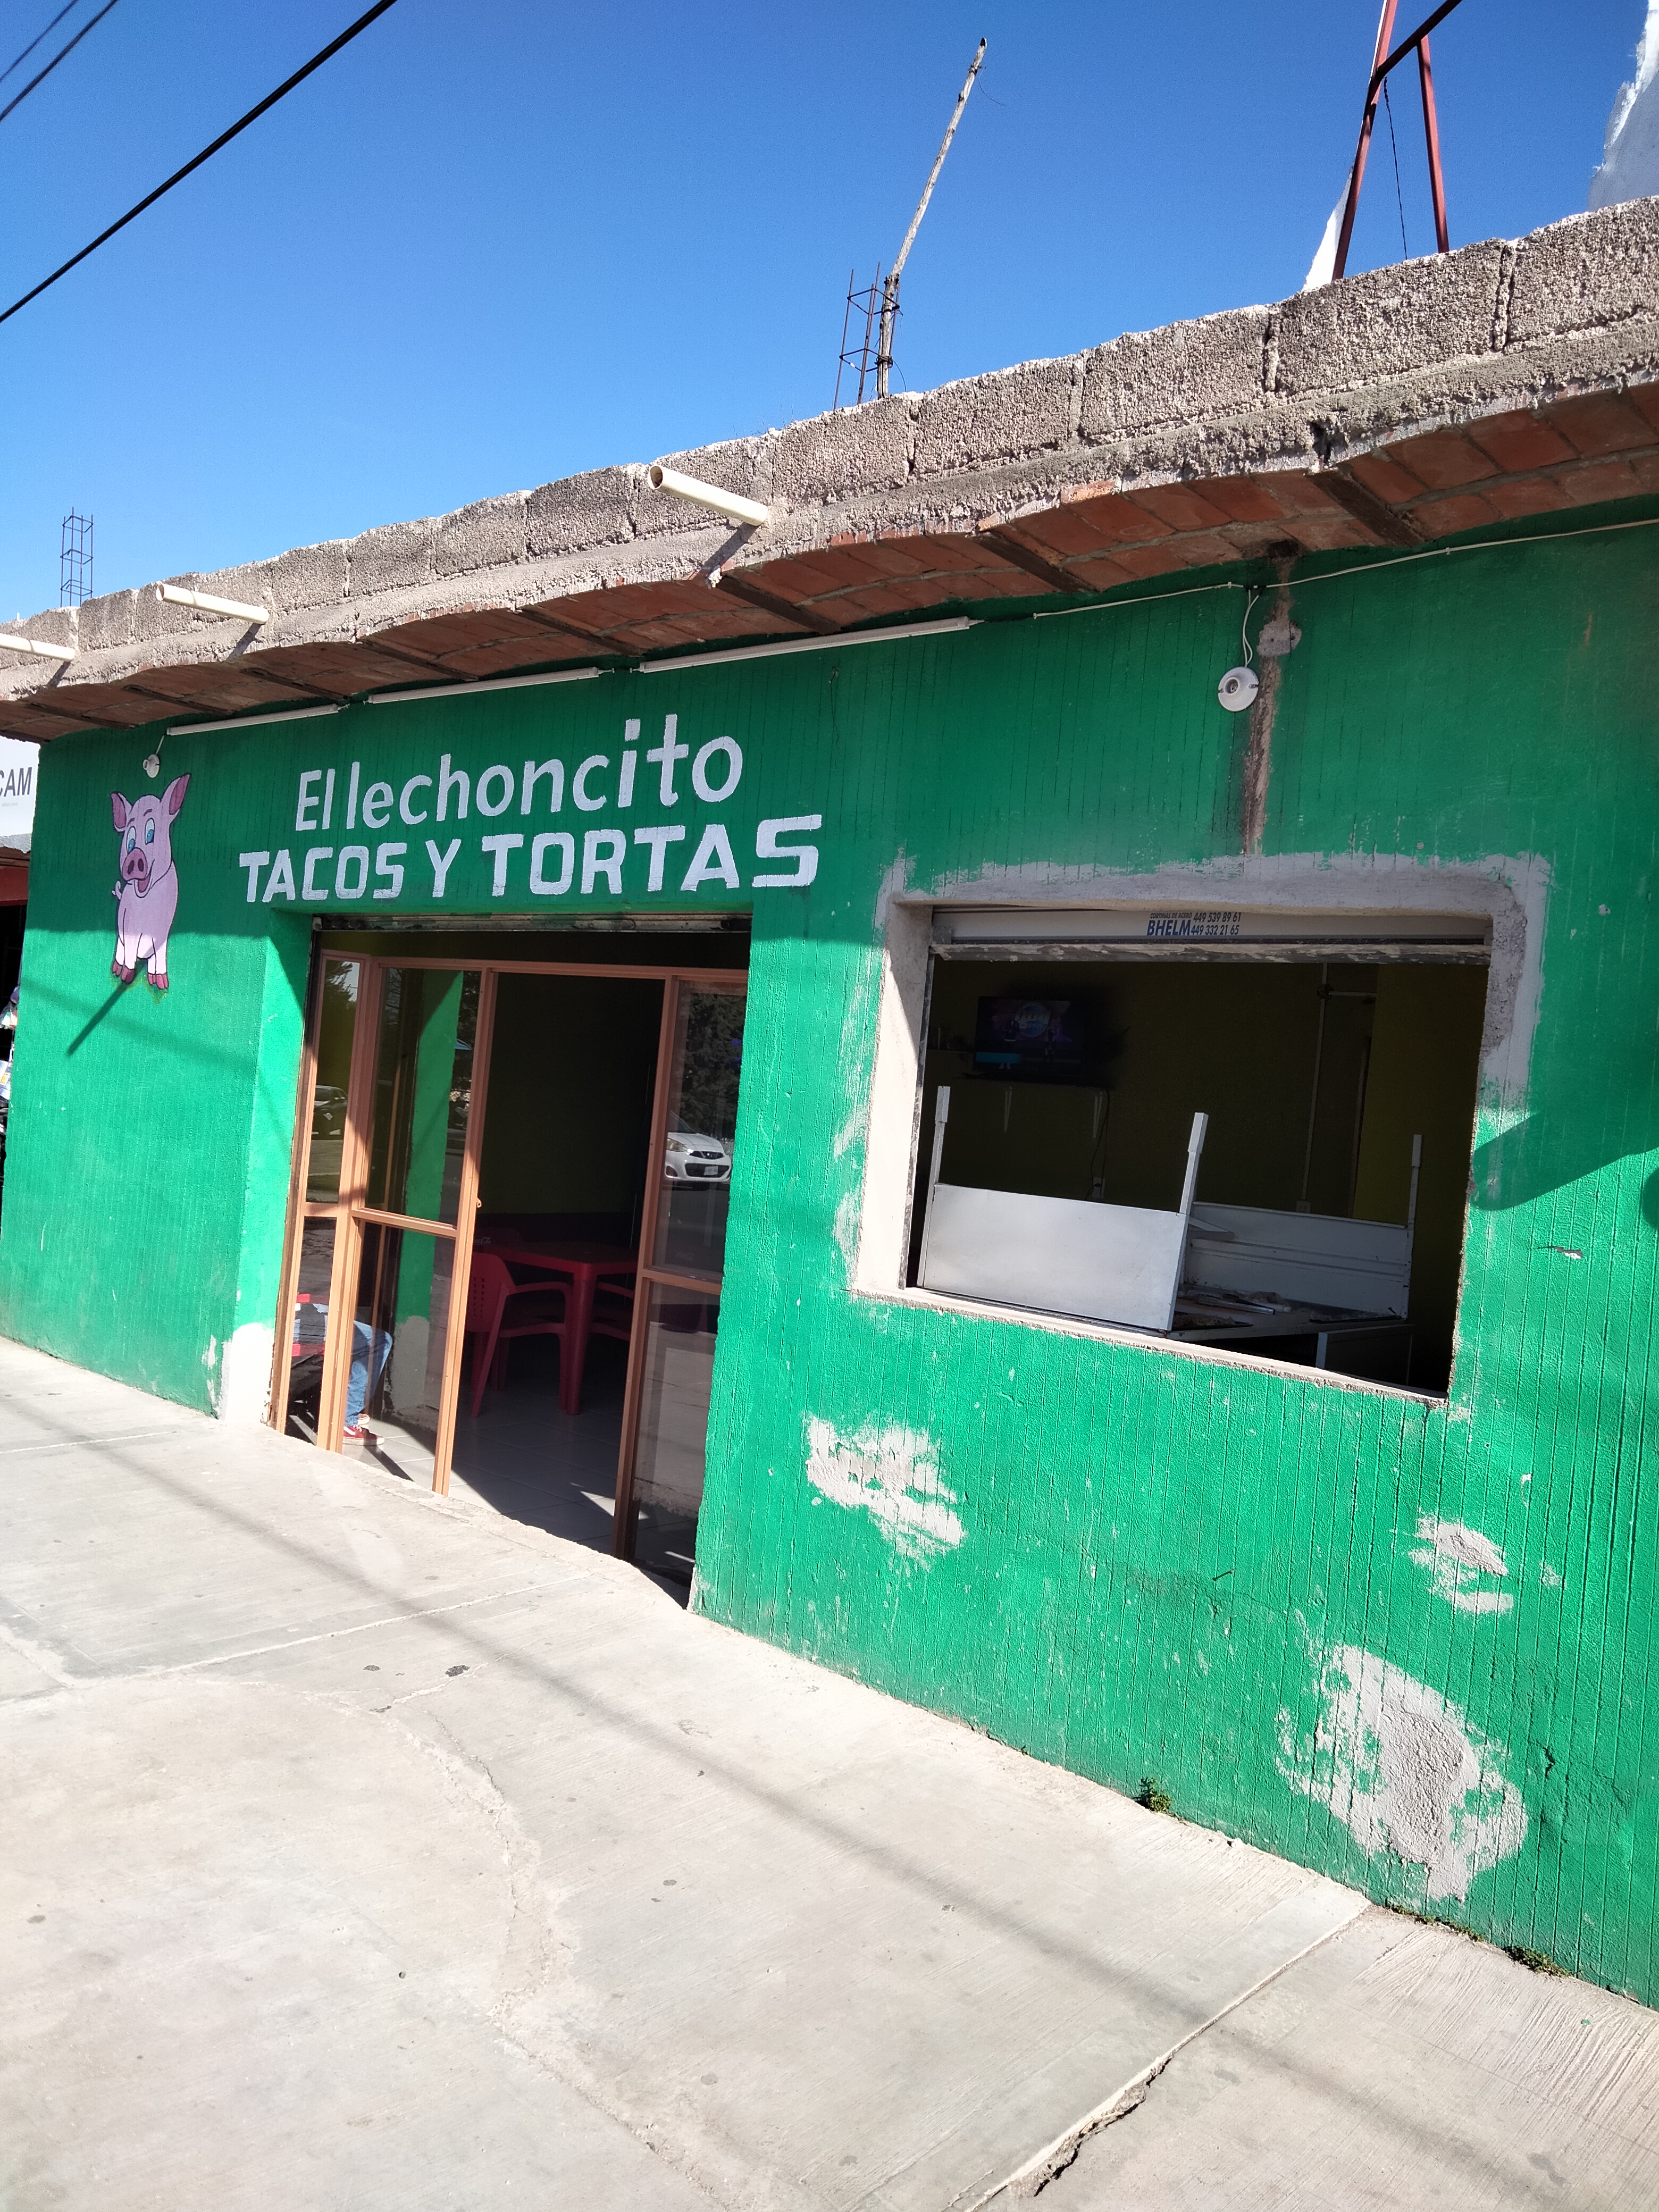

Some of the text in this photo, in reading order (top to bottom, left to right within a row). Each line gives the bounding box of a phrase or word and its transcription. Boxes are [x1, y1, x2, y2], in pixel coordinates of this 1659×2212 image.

[296, 714, 743, 831] El lechoncito
[239, 814, 822, 903] TACOS Y TORTAS
[1193, 911, 1242, 923] 449 539 89 61
[1146, 919, 1191, 936] BHELM
[1191, 925, 1239, 935] 449 332 21 65
